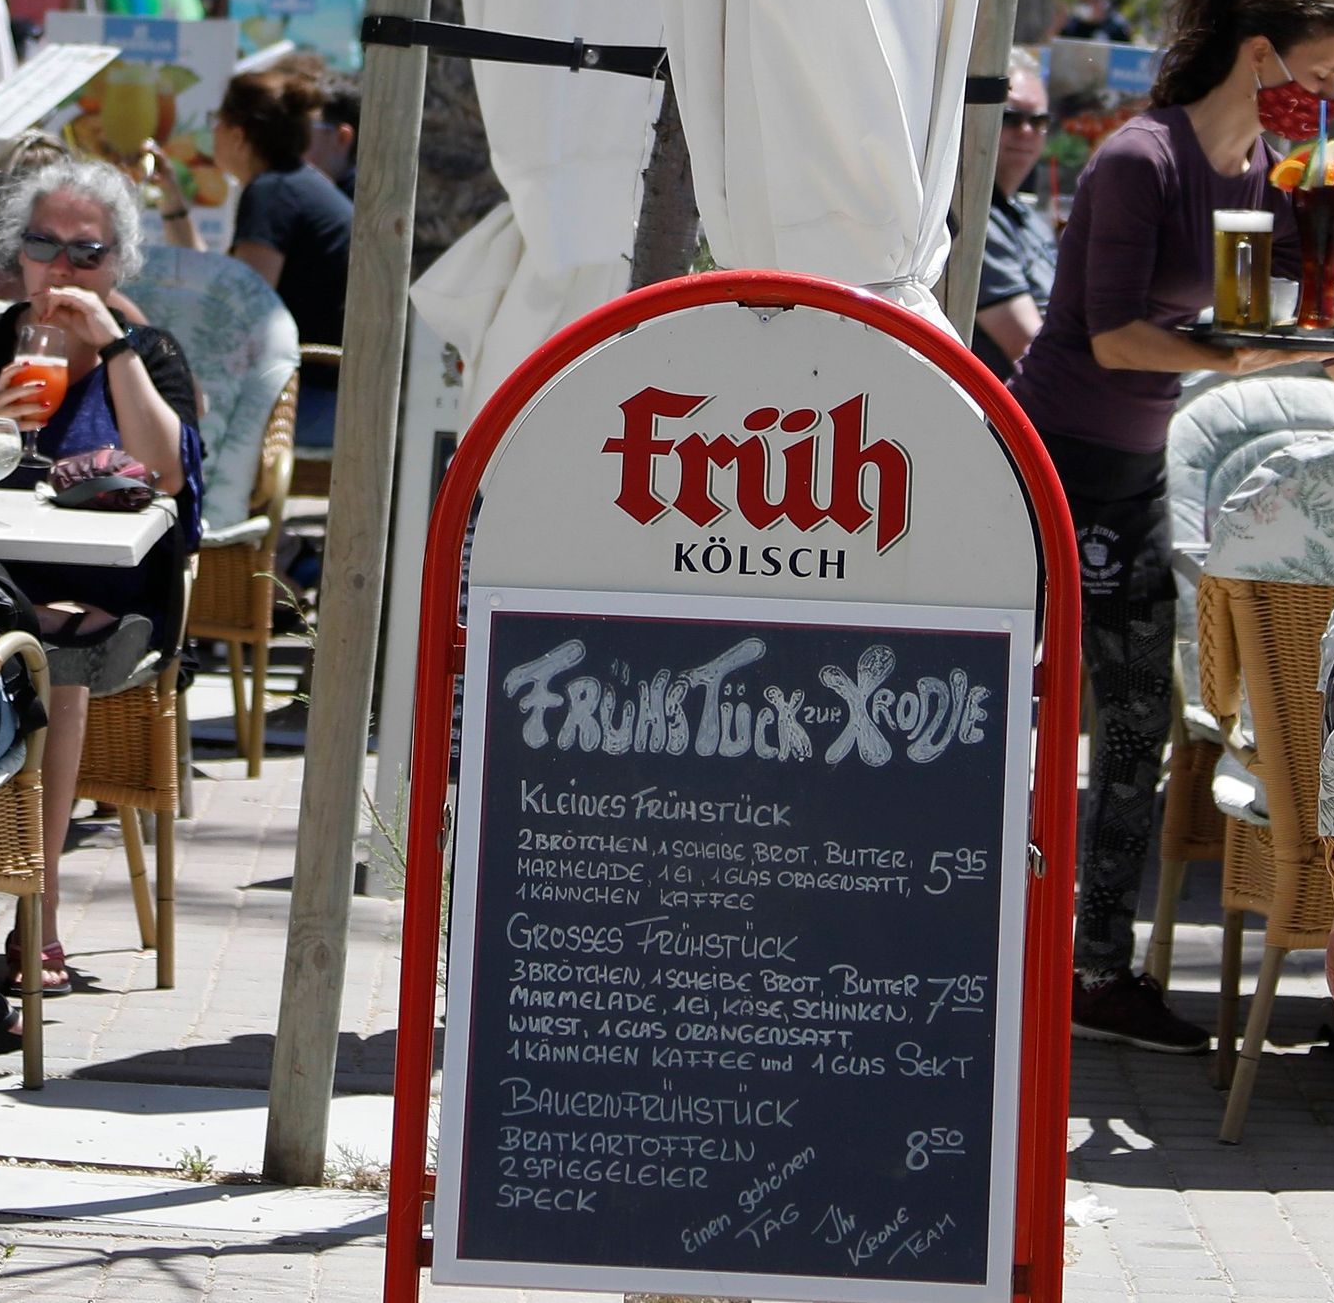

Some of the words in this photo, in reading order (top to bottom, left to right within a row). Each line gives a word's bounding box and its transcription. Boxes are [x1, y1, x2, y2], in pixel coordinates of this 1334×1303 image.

[673, 536, 847, 579] KÖLSCH
[761, 1054, 793, 1073] und
[497, 1126, 756, 1162] BRATKARTOFFELN
[495, 1183, 598, 1214] SPECK
